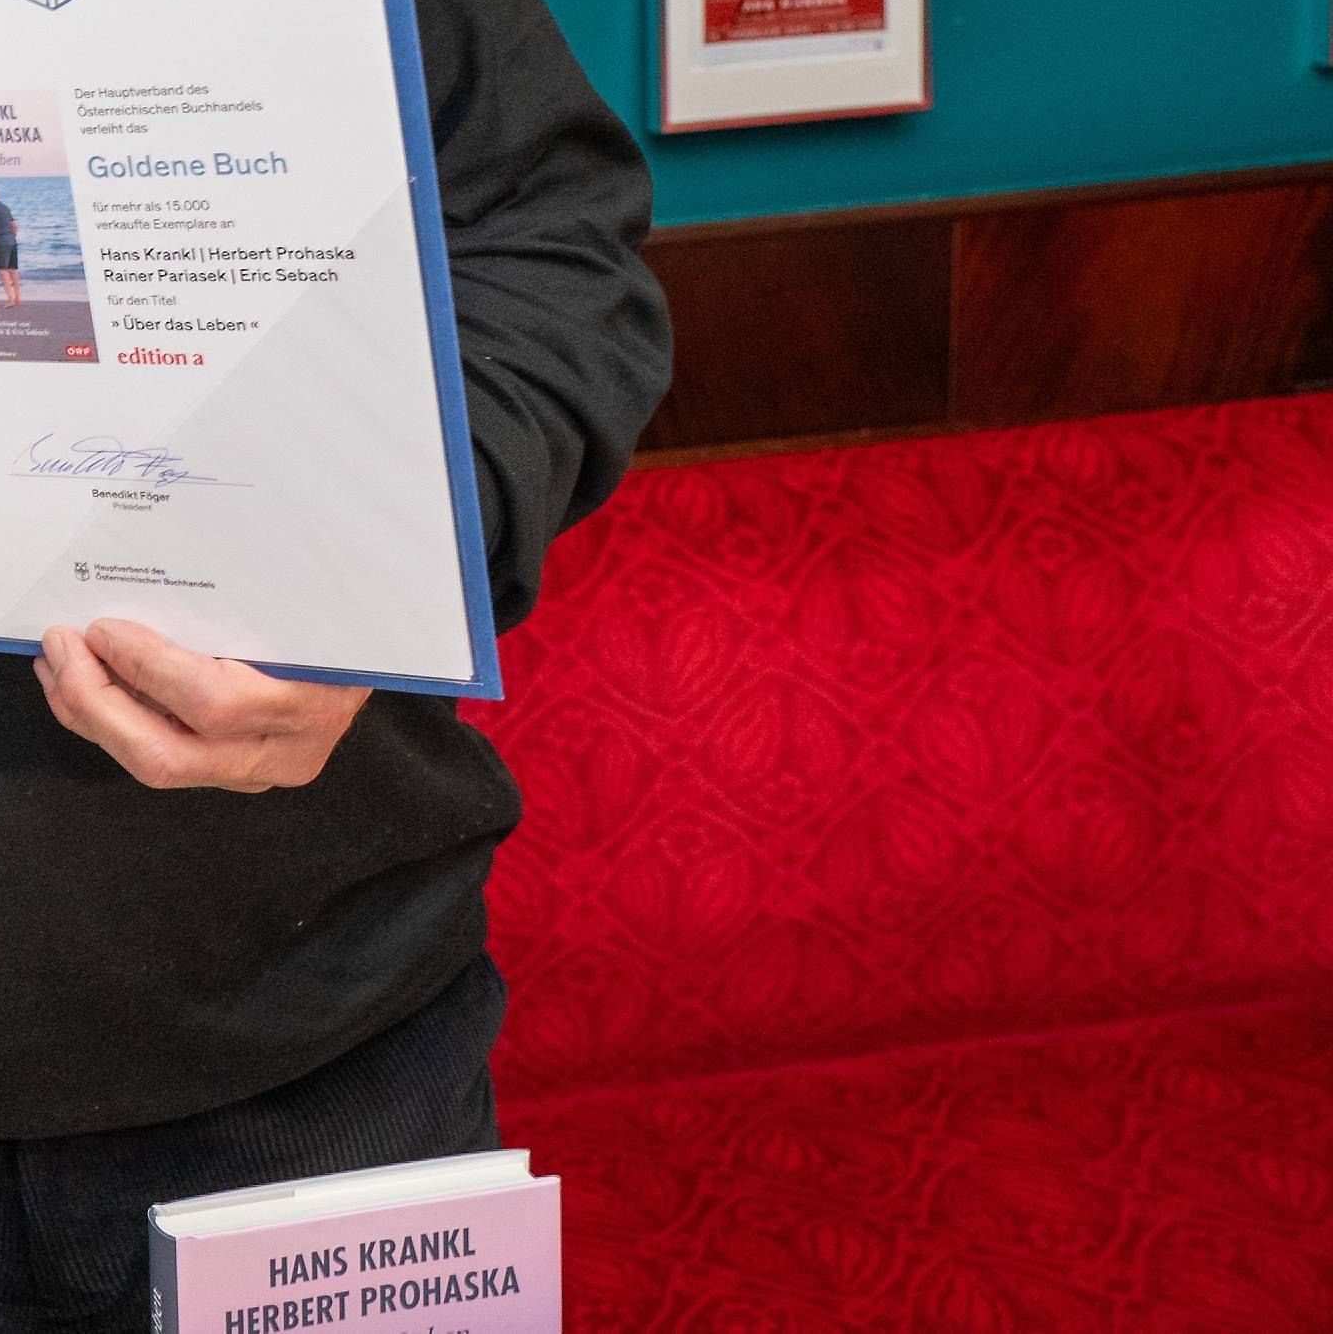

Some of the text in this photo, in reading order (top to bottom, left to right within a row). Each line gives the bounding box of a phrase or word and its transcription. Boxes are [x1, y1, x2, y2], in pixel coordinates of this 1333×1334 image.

[74, 84, 209, 99] Der Hauptverband des
[77, 101, 263, 117] Österreichischen Buchhandels
[79, 123, 148, 135] verleiht das
[87, 150, 288, 178] Goldene Buch
[92, 200, 210, 213] für mehr als 15.000
[95, 218, 235, 231] verkaufte Exemplare an
[100, 248, 140, 262] Hans
[144, 247, 196, 262] Krankl
[208, 246, 272, 261] Herbert
[277, 246, 355, 261] Prohaska
[103, 269, 154, 282] Rainer
[158, 268, 227, 282] Pariasek
[240, 268, 272, 282] Eric
[276, 267, 339, 282] Sebach
[107, 295, 176, 306] für den Titel
[123, 314, 161, 330] Über
[164, 319, 193, 331] das
[196, 318, 246, 331] Leben
[67, 346, 93, 357] ORF
[117, 346, 204, 365] edition a
[92, 489, 170, 503] Benedikt Föger
[94, 564, 166, 576] Hauptverband des
[95, 573, 216, 590] Österreichischen Buchhandels
[269, 1226, 477, 1287] HANS KRANKL
[225, 1265, 521, 1334] HERBERT PROHASKA
